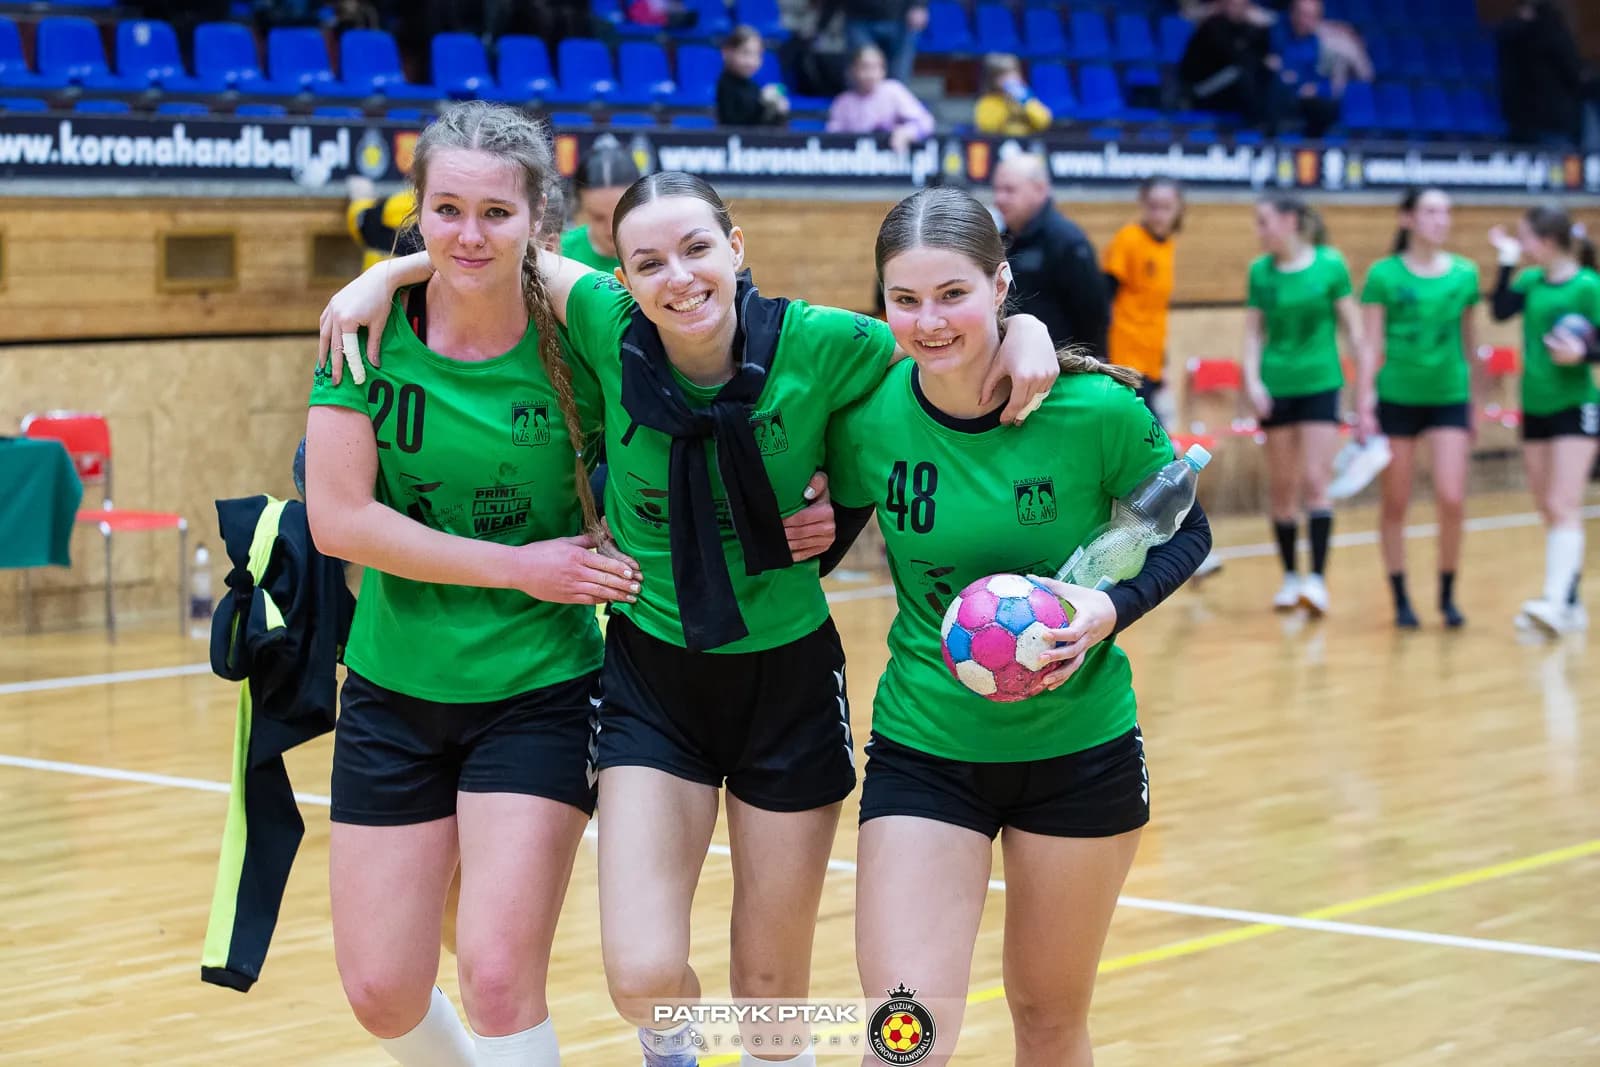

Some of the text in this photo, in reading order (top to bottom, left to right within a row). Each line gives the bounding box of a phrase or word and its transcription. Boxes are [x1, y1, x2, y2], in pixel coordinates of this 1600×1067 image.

[367, 379, 426, 454] 20
[475, 487, 518, 499] PRINT
[886, 460, 938, 534] 48
[473, 499, 530, 515] ACTIVE
[1021, 507, 1036, 521] AZS
[473, 511, 529, 534] WEAR
